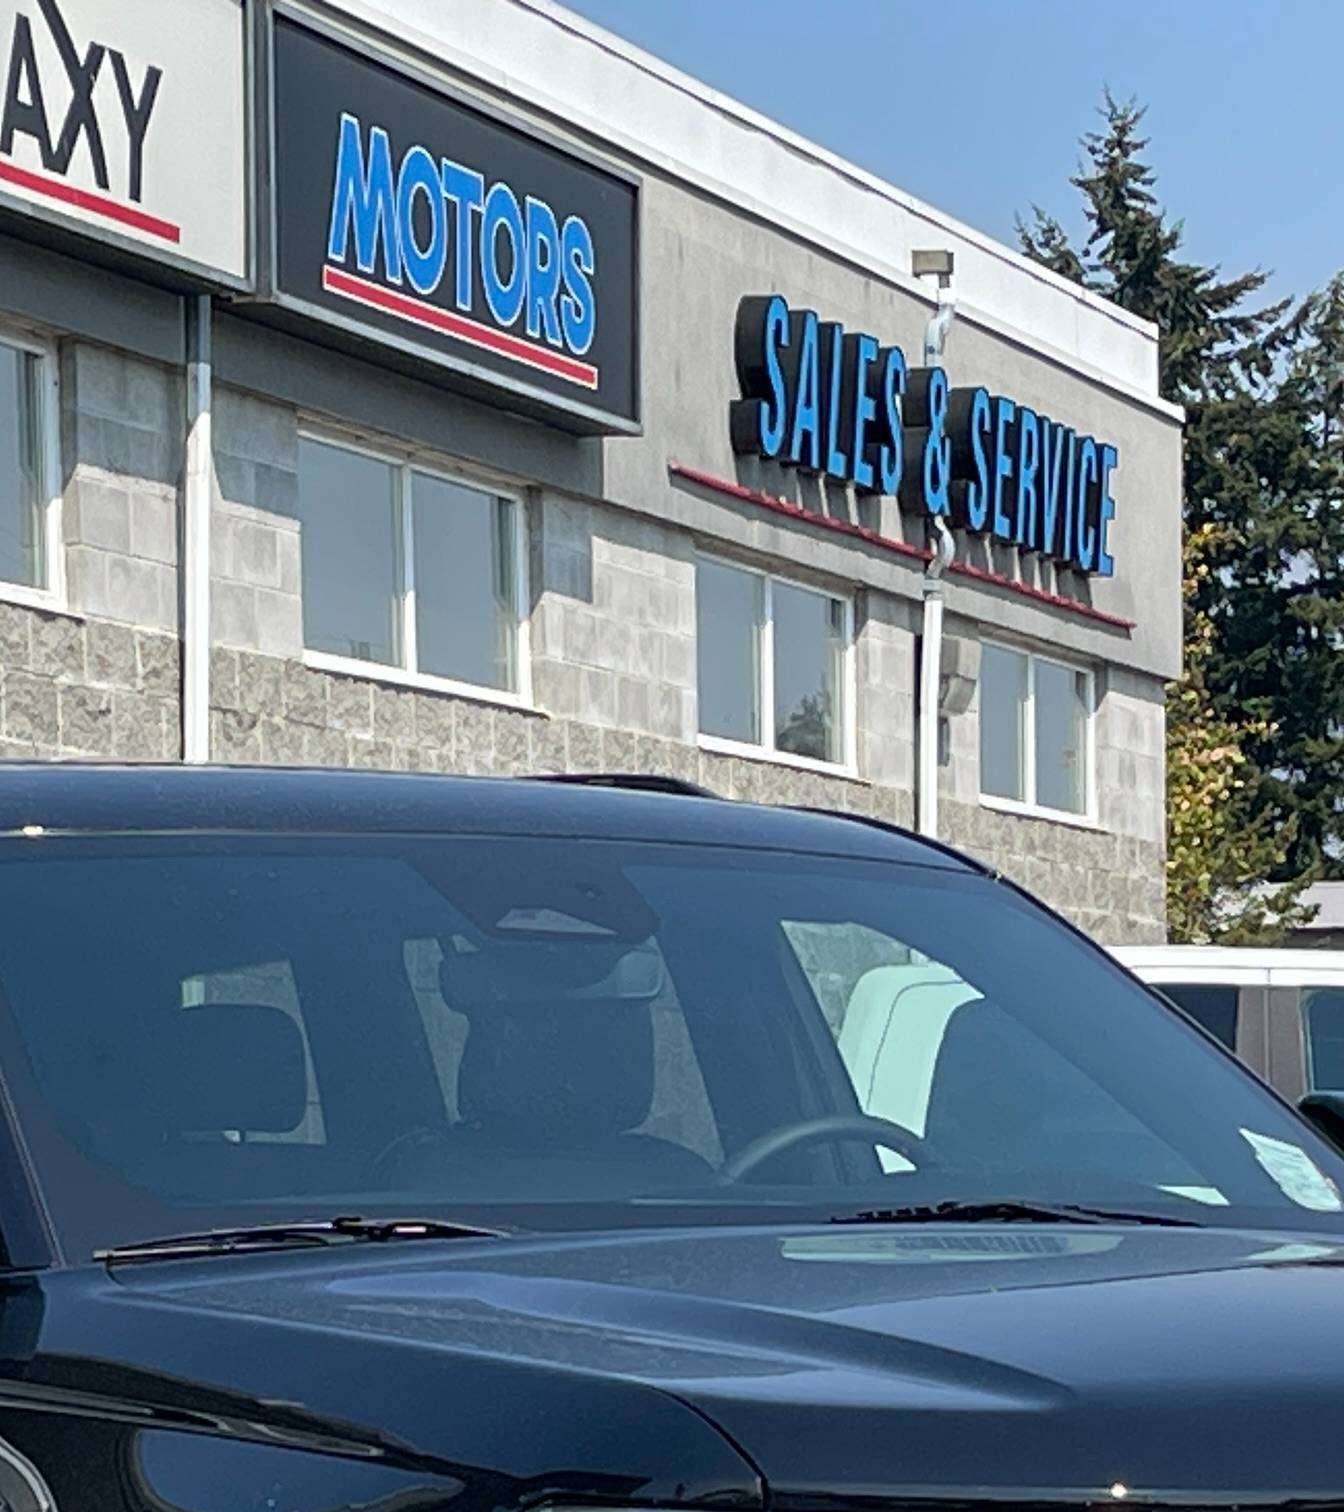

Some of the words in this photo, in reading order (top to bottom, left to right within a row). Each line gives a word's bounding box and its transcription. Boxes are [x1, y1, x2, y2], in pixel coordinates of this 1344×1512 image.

[327, 111, 597, 356] MOTORS
[757, 294, 907, 496] SALES
[922, 368, 951, 517] &
[966, 387, 1120, 578] SERVICE
